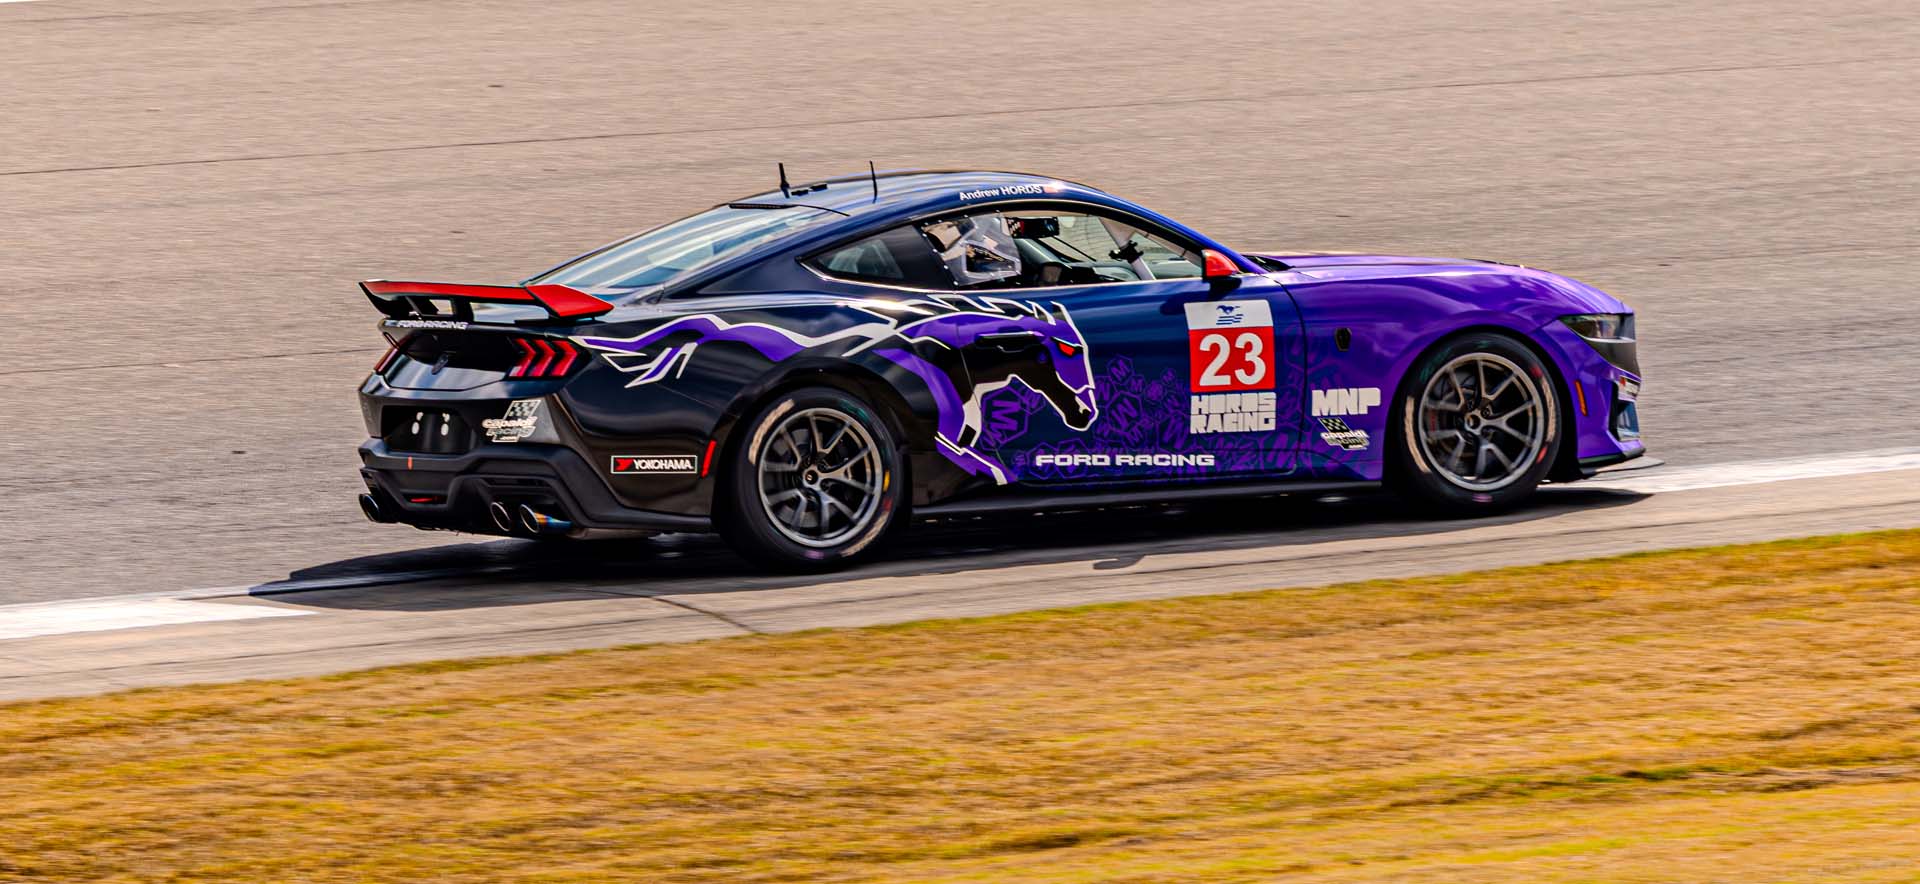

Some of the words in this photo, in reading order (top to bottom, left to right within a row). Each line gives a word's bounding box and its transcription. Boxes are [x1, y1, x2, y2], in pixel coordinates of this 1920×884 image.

[960, 188, 999, 200] Andrew
[1000, 184, 1042, 196] HORDS
[1199, 332, 1266, 386] 23
[1312, 387, 1381, 416] MNP
[1190, 412, 1276, 434] RACING
[633, 459, 694, 470] YOKOHAMA
[1036, 454, 1111, 466] FORD
[1115, 454, 1215, 467] RACING
